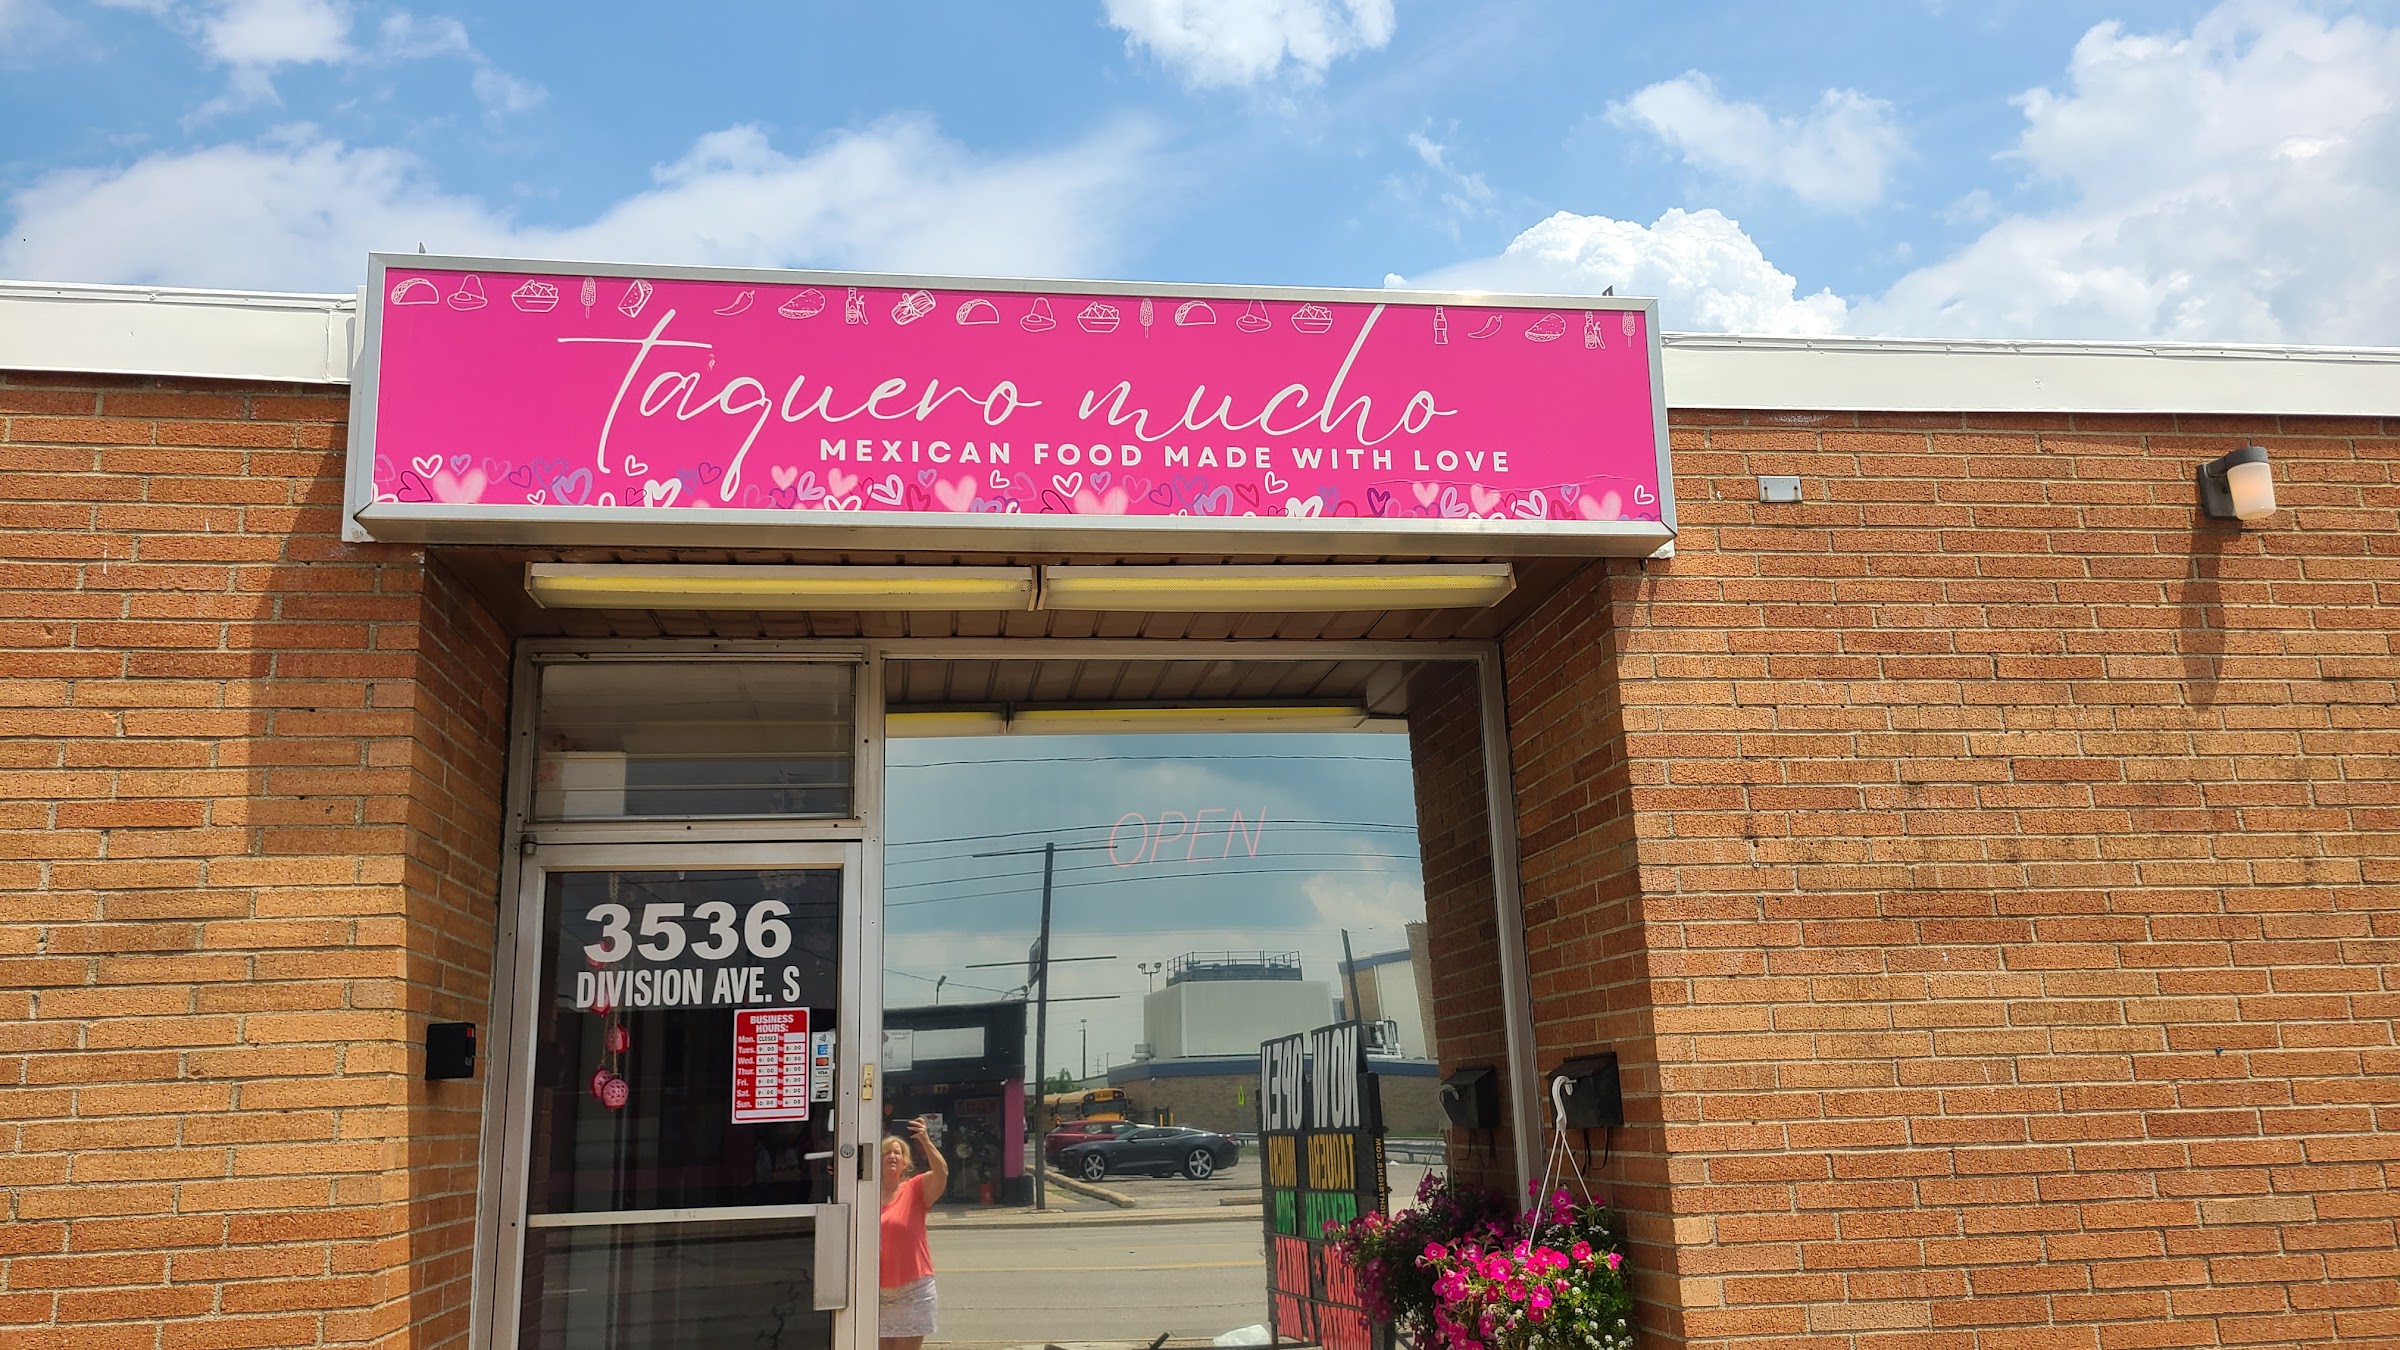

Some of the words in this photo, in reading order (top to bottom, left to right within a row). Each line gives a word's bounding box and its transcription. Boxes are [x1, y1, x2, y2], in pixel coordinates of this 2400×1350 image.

[558, 308, 1042, 501] taquero
[1078, 303, 1458, 447] mucho
[819, 438, 1012, 464] MEXICAN
[1034, 442, 1143, 468] FOOD
[1164, 446, 1272, 470] MADE
[1292, 447, 1394, 472] WITH
[1413, 449, 1511, 473] LOVE
[1108, 806, 1267, 868] OPEN
[583, 900, 792, 962] 3536
[576, 968, 704, 1008] DIVISION
[711, 966, 772, 1005] AVE.
[782, 965, 801, 1002] S
[750, 1014, 794, 1024] BUSINESS
[756, 1024, 789, 1033] HOURS:
[738, 1035, 755, 1043] Mon.
[738, 1046, 757, 1054] Tues.
[738, 1056, 755, 1065] Wed.
[737, 1067, 756, 1075] Thur.
[736, 1078, 749, 1086] Fri.
[736, 1089, 751, 1097] Sat.
[736, 1100, 752, 1108] Sun.
